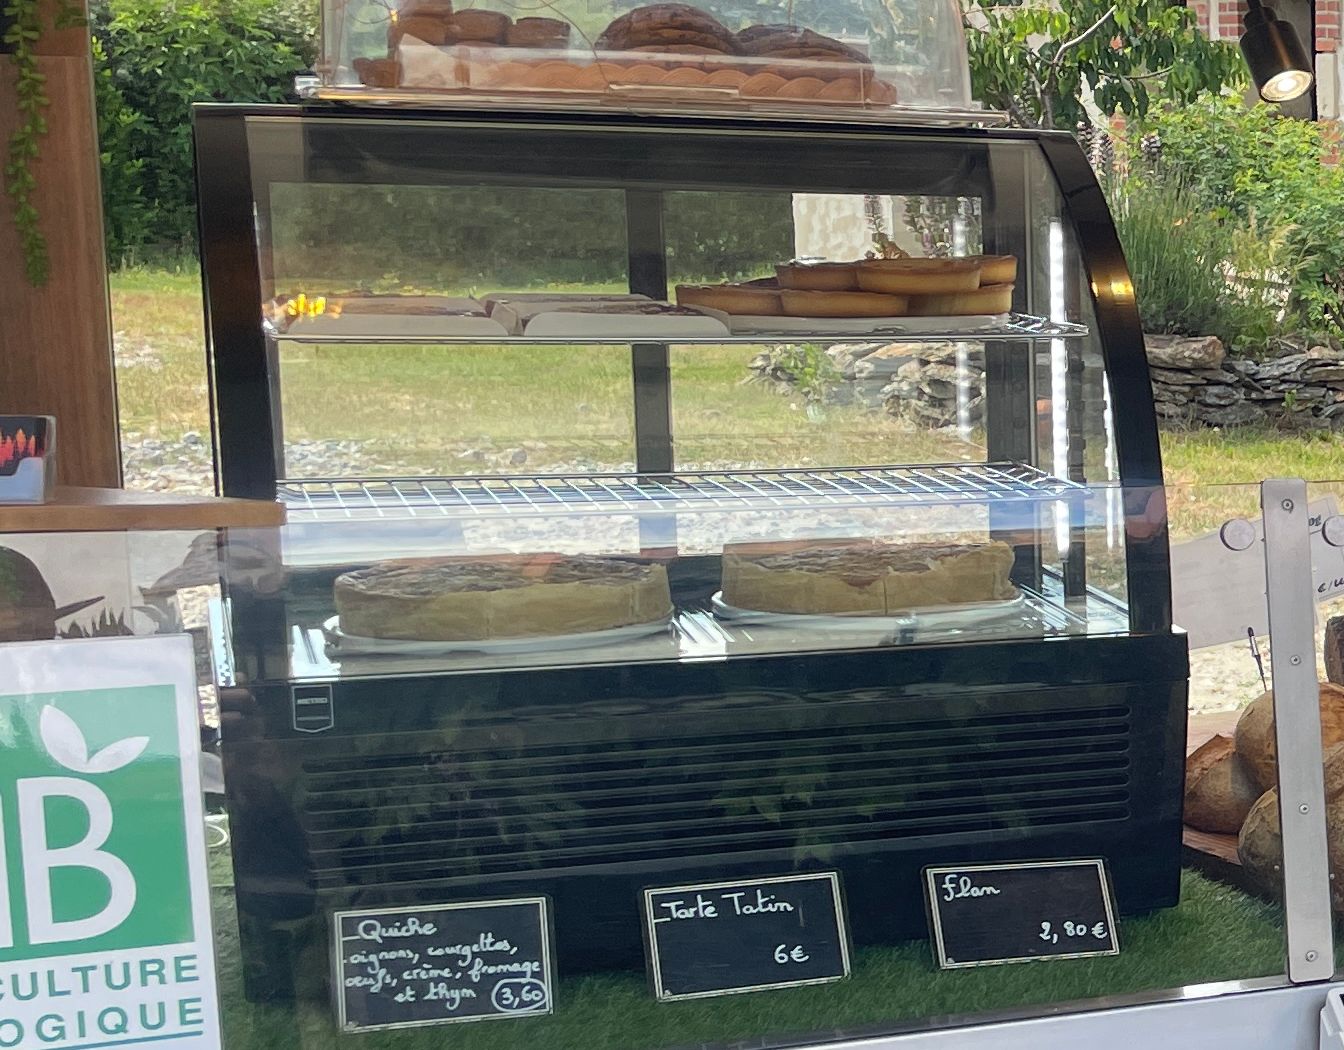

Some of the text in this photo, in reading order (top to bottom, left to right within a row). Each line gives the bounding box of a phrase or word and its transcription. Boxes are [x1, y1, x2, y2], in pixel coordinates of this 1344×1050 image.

[660, 889, 794, 919] Tarte Tatin
[358, 917, 437, 943] Quiche
[0, 954, 200, 1001] ULTURE
[468, 957, 541, 982] fromage
[394, 982, 477, 1010] et thym
